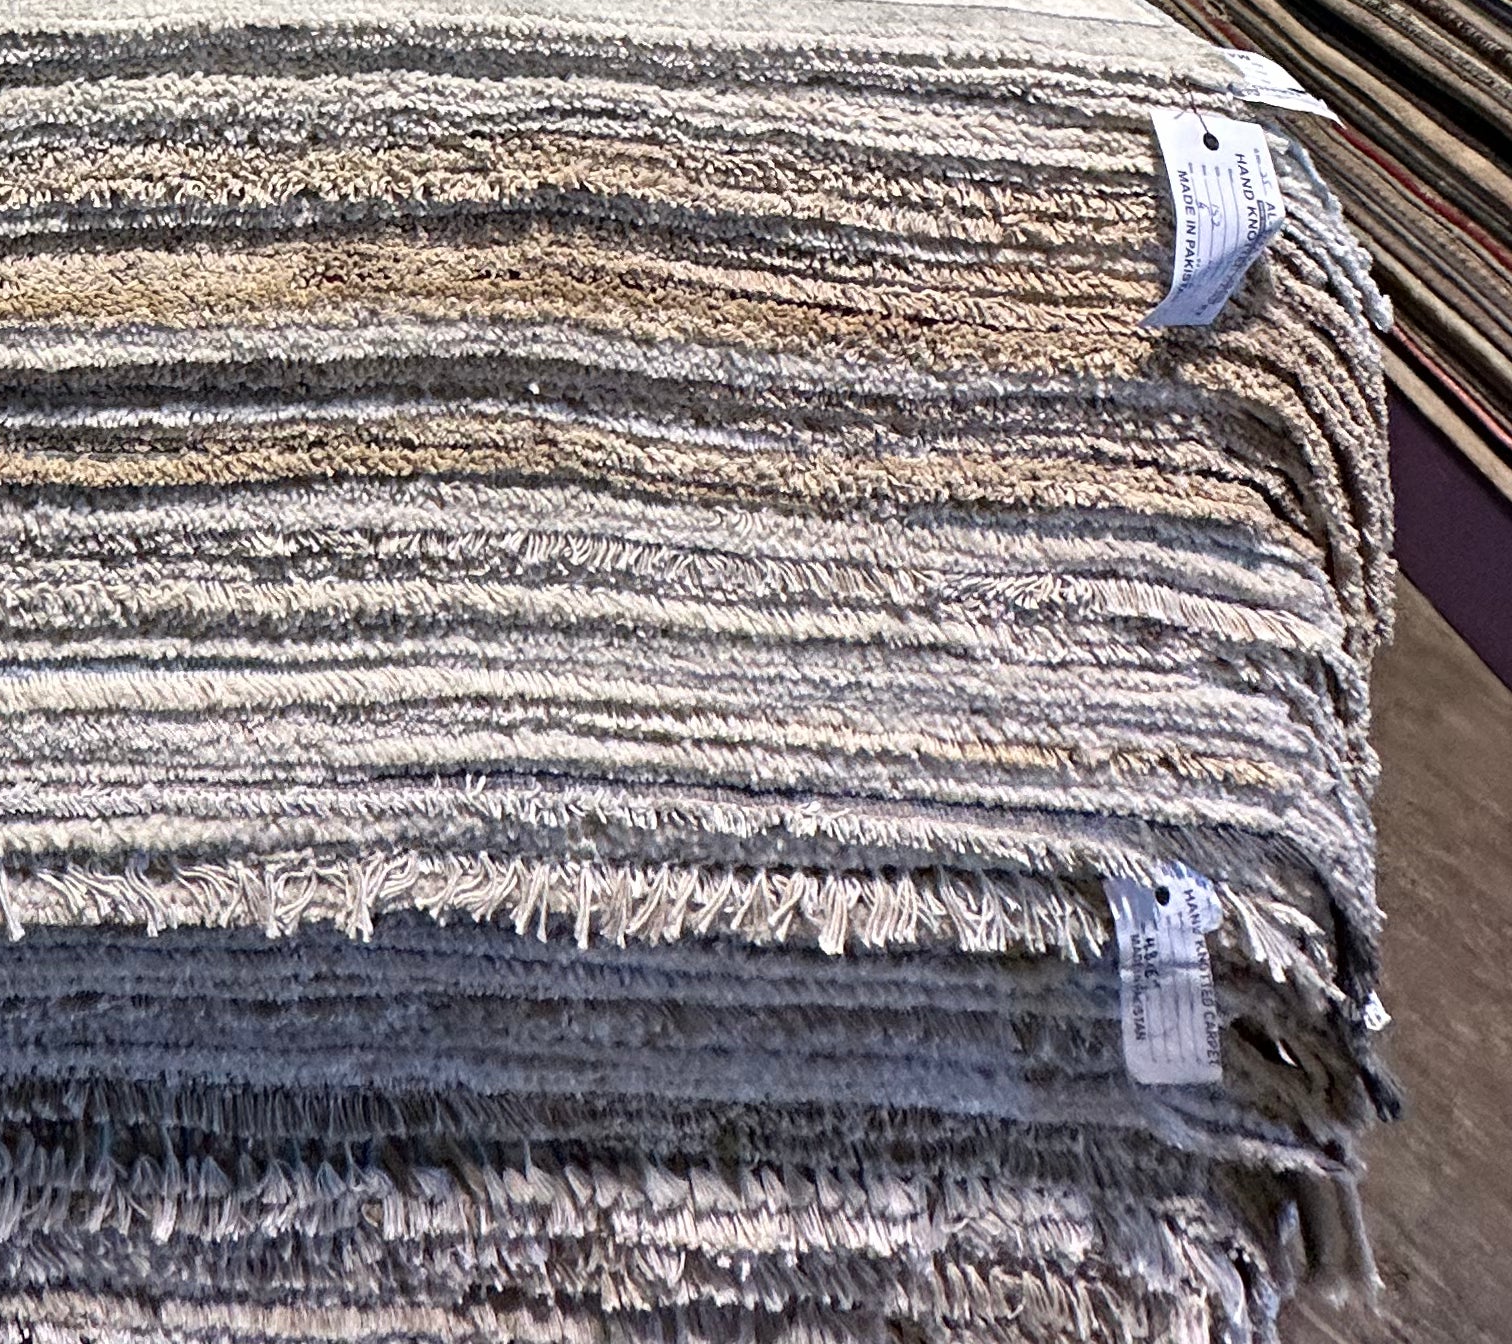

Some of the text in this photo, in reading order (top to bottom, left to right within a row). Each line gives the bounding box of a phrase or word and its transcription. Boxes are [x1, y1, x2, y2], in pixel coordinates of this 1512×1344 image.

[1177, 170, 1196, 216] MADE
[1235, 153, 1255, 201] HAND
[1185, 219, 1197, 235] IN
[1204, 1010, 1221, 1065] CARPET
